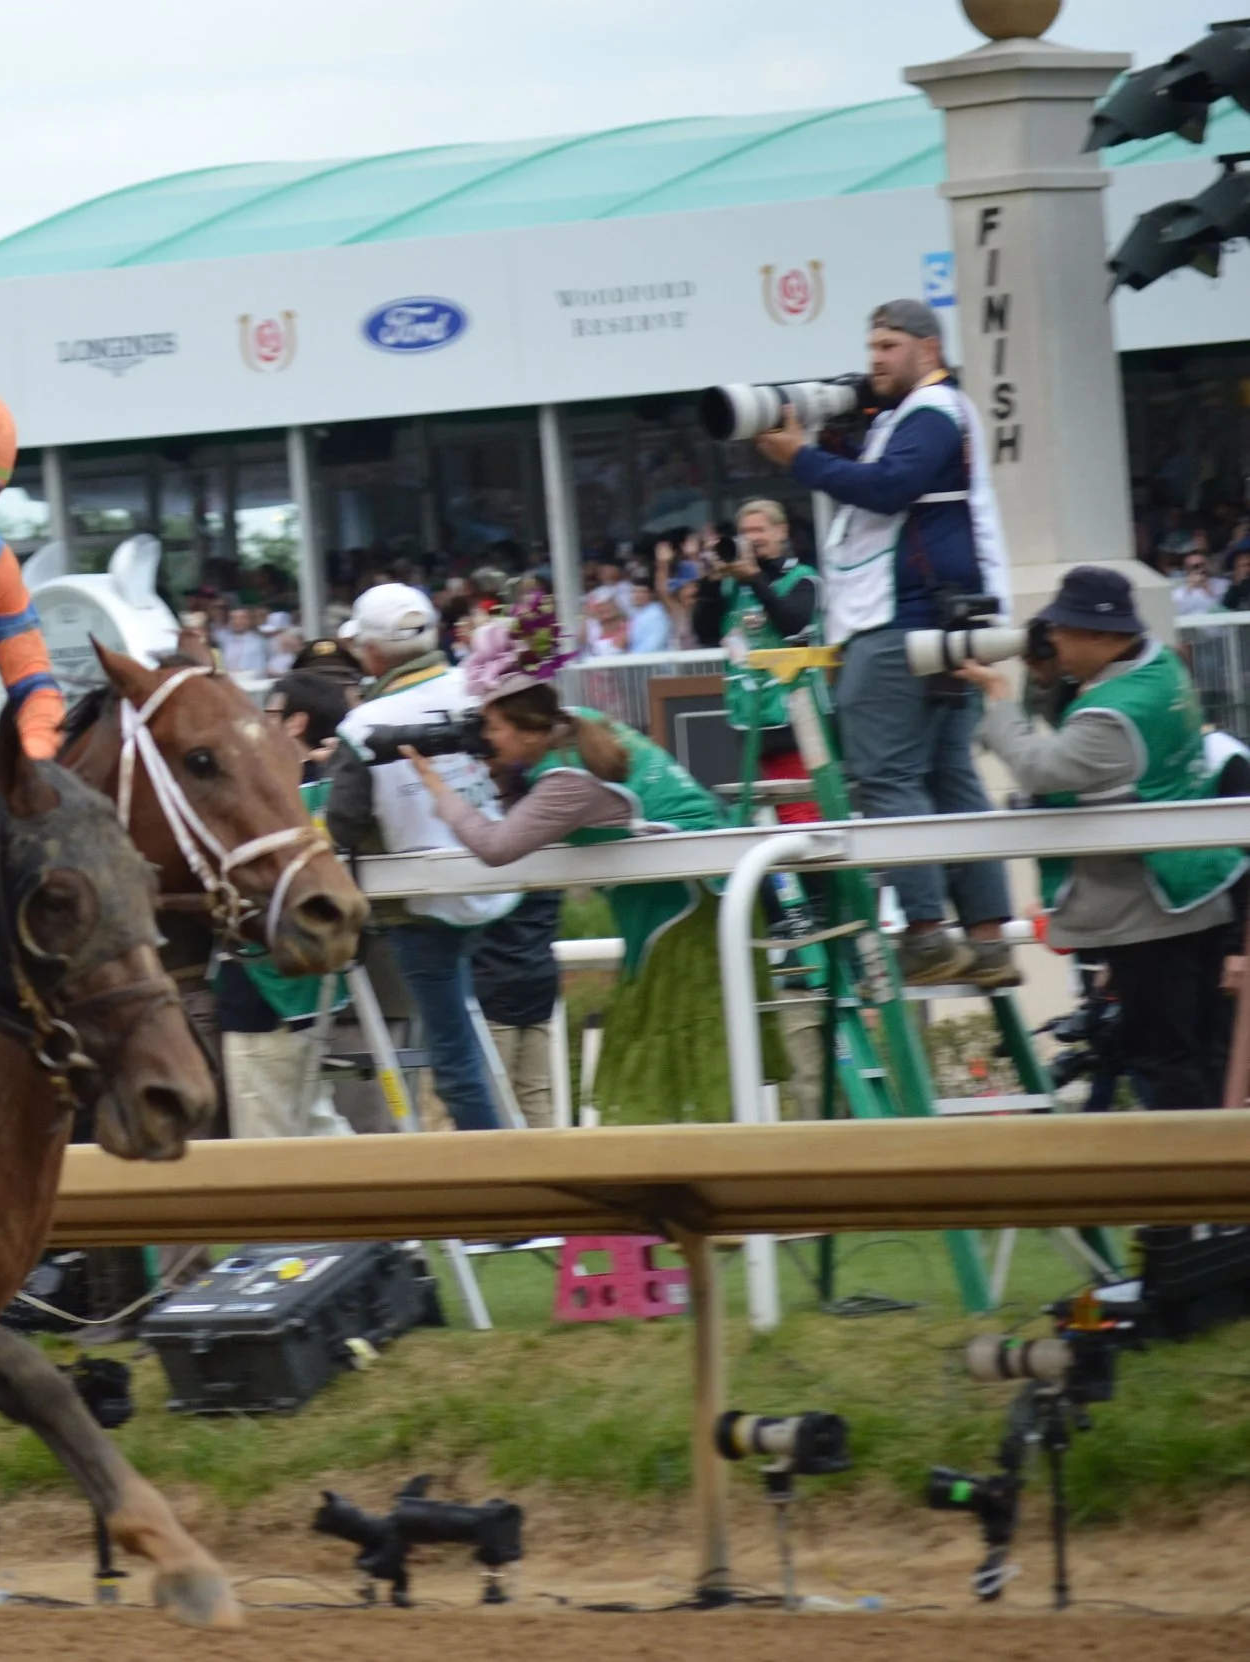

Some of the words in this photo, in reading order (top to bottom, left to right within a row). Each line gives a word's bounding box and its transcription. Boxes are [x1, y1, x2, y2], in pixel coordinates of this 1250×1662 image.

[554, 280, 696, 308] WOODFORD
[378, 304, 452, 345] Ford
[571, 311, 690, 338] RESERVE
[977, 206, 1022, 465] FINISH
[55, 331, 177, 363] LONGINES
